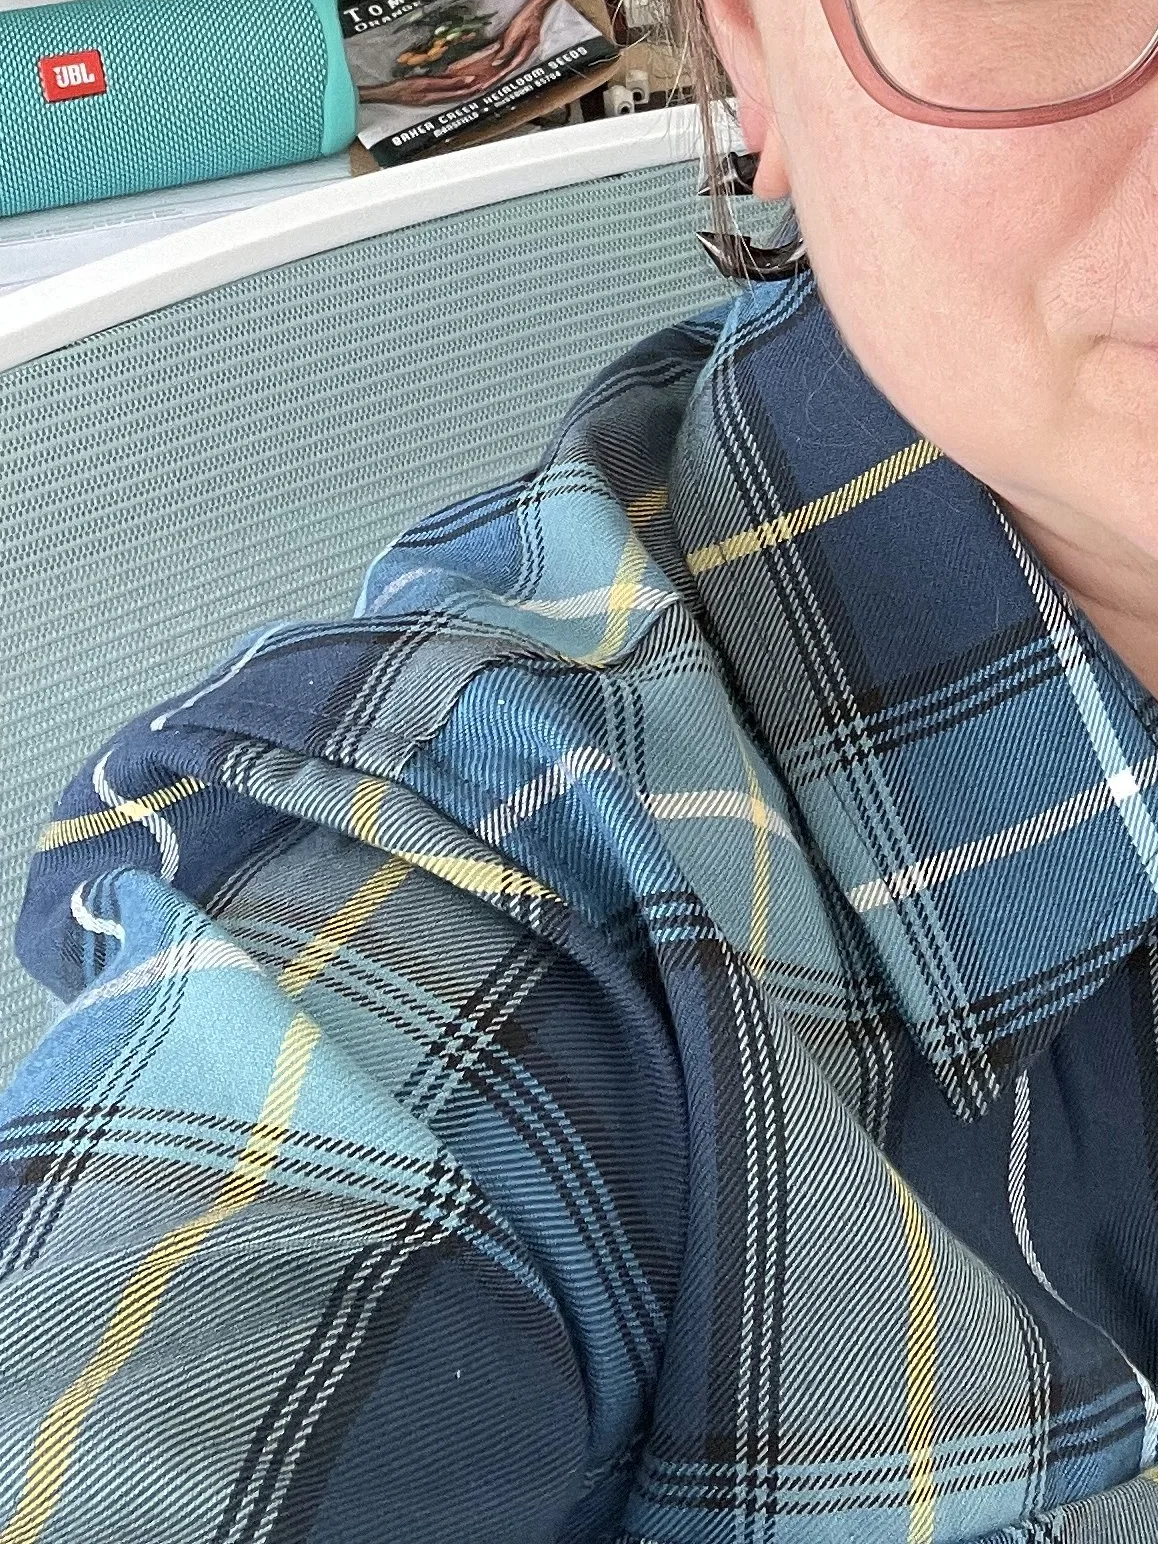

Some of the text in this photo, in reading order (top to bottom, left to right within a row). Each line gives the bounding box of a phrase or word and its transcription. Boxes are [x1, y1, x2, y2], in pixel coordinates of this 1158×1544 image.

[52, 62, 96, 88] JBL
[391, 46, 588, 148] BAKER CREEK HEIRLOOM SEEDS
